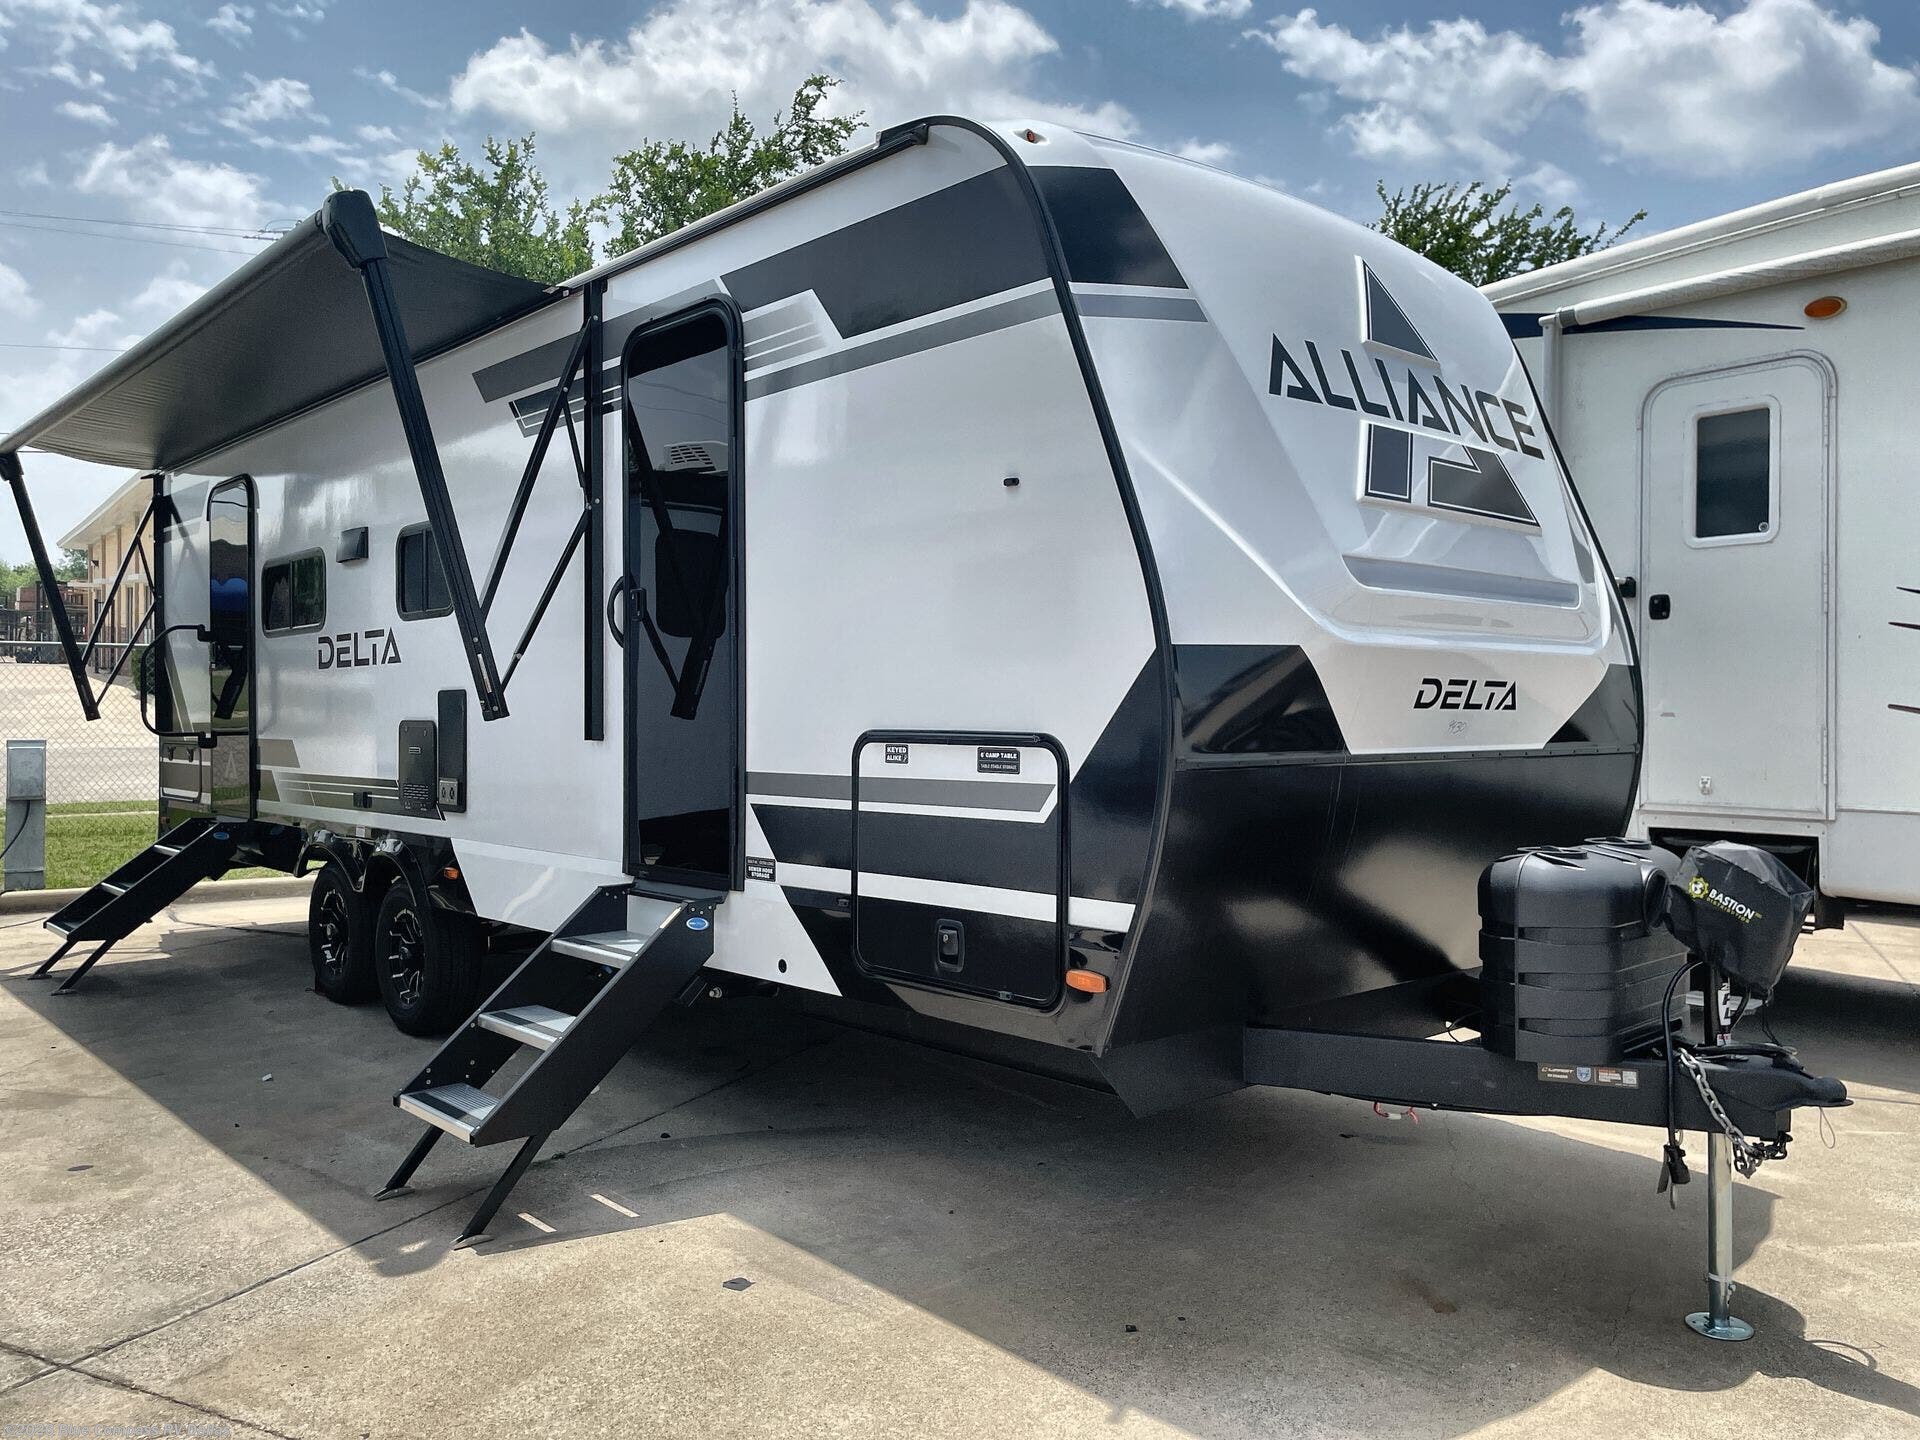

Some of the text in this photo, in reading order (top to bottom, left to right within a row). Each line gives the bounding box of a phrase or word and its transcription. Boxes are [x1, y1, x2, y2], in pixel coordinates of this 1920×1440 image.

[1268, 332, 1545, 460] ALLIANCE
[317, 628, 401, 669] DELTA
[1413, 677, 1518, 711] DELTA
[1709, 888, 1756, 920] BASTION
